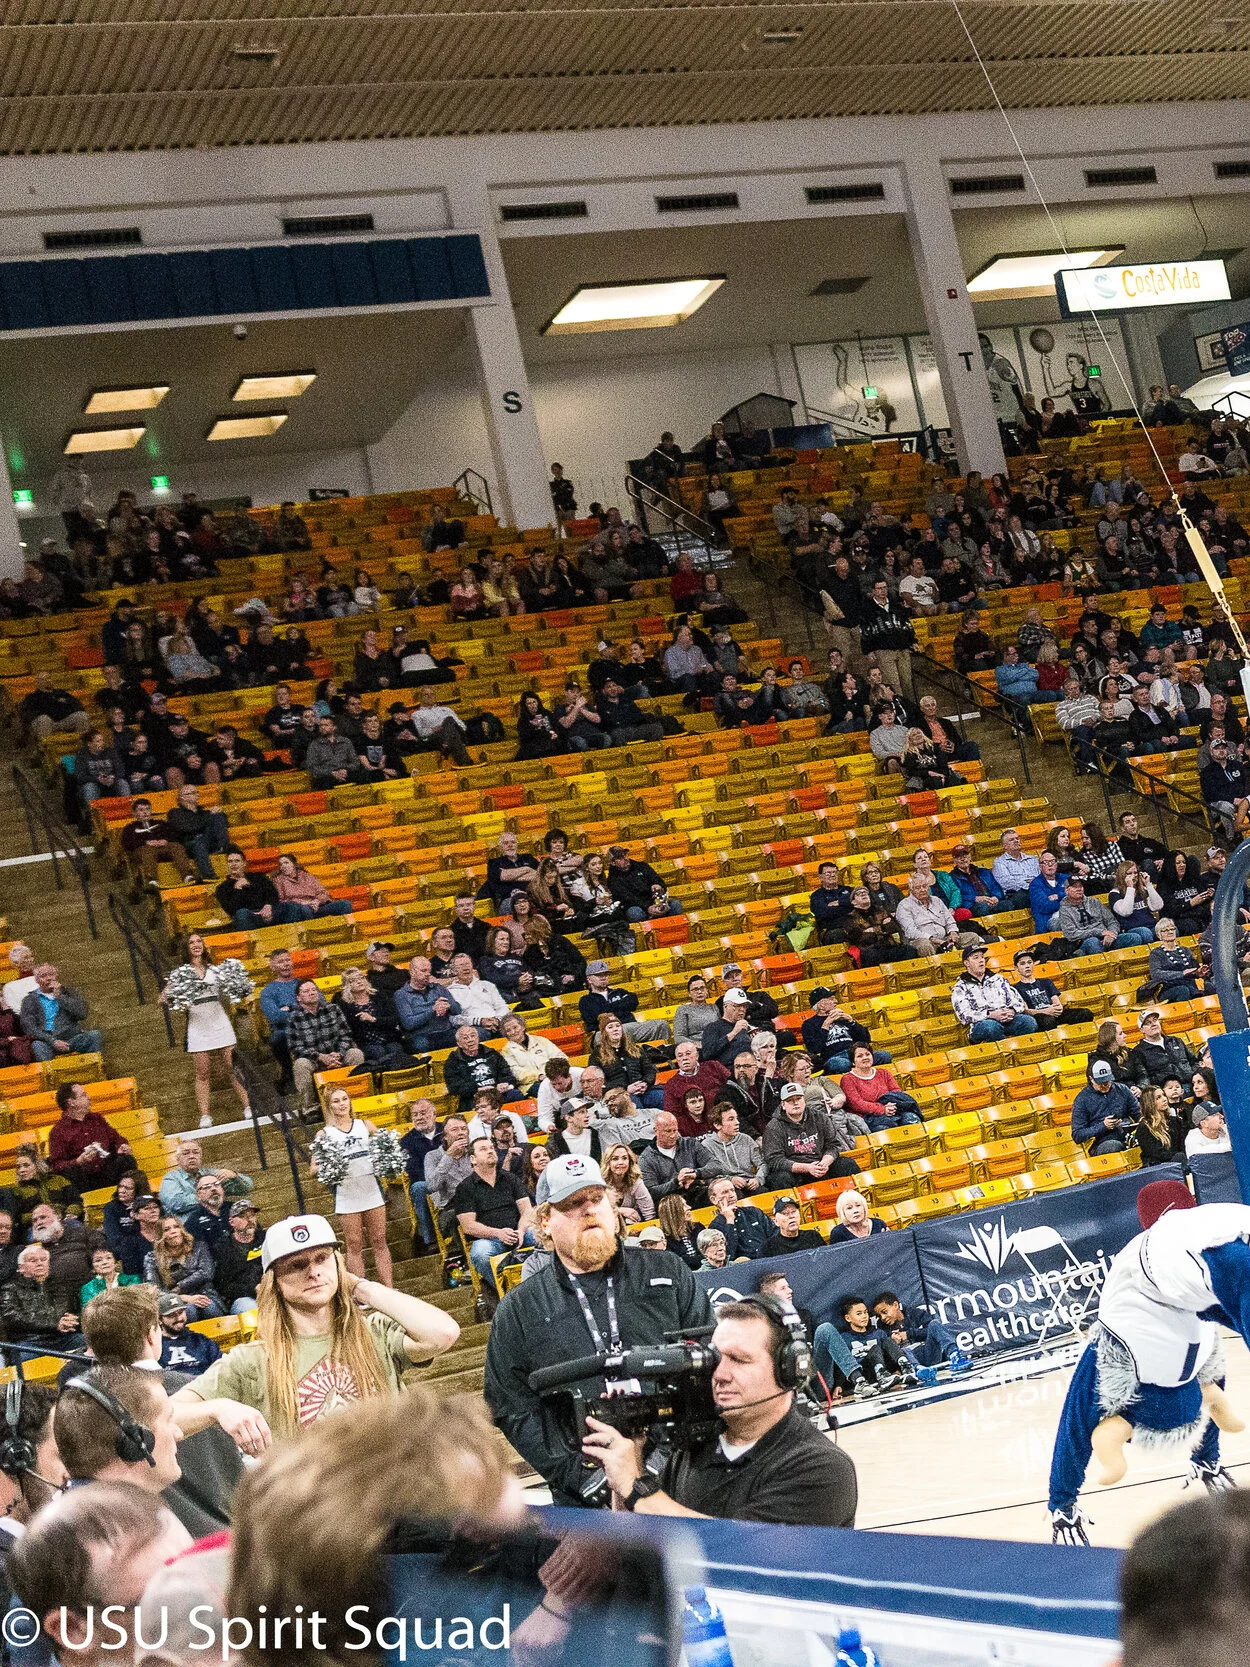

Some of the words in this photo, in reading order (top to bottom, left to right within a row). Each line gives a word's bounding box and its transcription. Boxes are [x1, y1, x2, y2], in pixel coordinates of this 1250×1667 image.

[958, 351, 974, 371] T
[502, 391, 522, 413] S
[955, 1301, 1083, 1352] ealthcare
[168, 1346, 196, 1365] A
